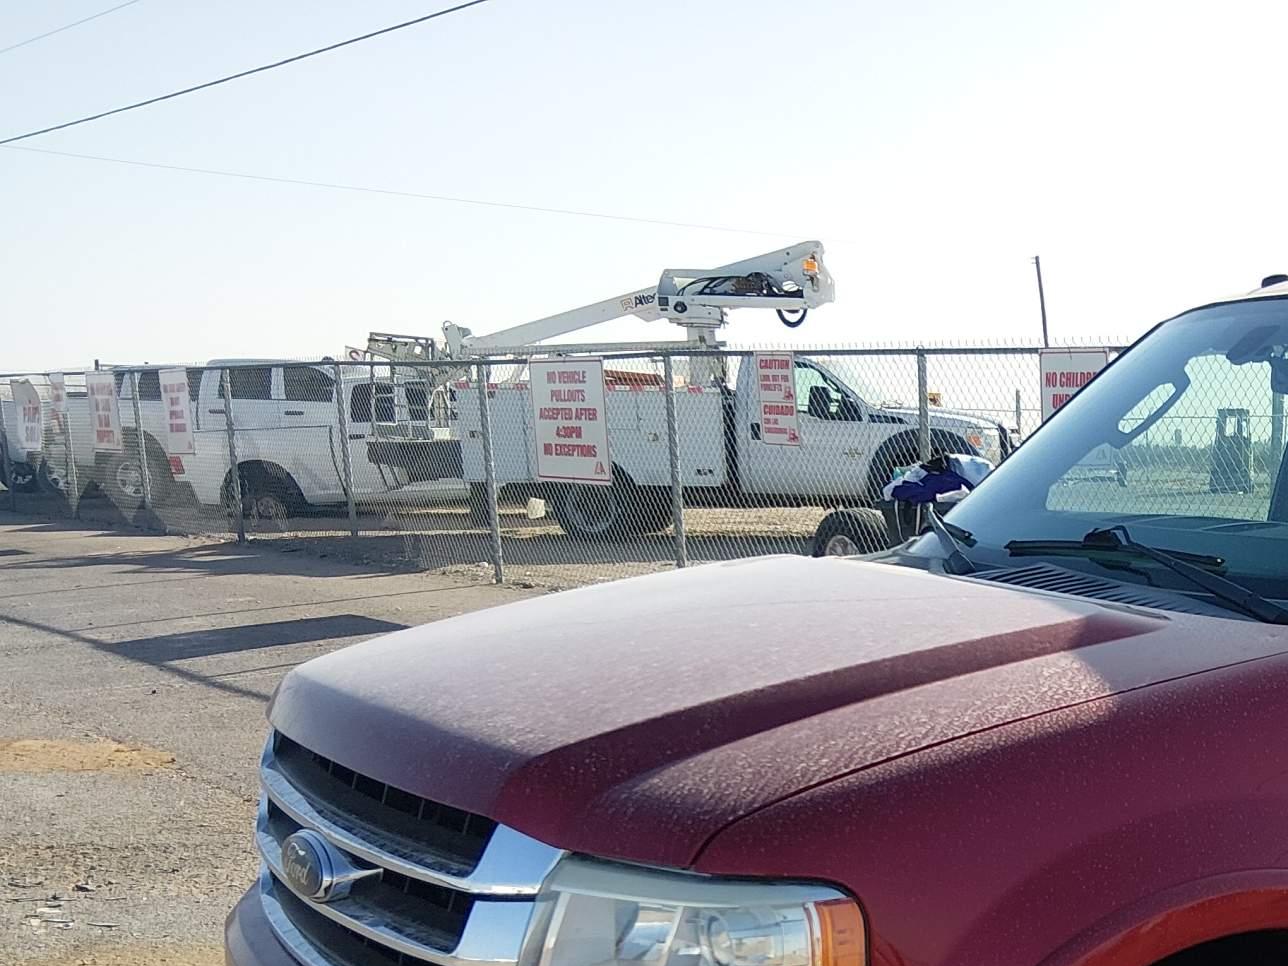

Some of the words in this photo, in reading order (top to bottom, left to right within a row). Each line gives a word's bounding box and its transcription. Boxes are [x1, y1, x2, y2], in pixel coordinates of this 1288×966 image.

[760, 359, 790, 369] CAUTION
[547, 371, 556, 384] NO
[558, 371, 586, 384] VEHICLE
[1046, 372, 1057, 387] NO
[1060, 372, 1097, 388] CHILDR
[551, 390, 585, 402] PULLOUTS
[539, 408, 573, 420] ACCEPTED
[575, 408, 597, 420] AFTER
[764, 405, 794, 416] CUIDADO
[544, 443, 553, 456] NO
[555, 444, 597, 457] EXCEPTIONS
